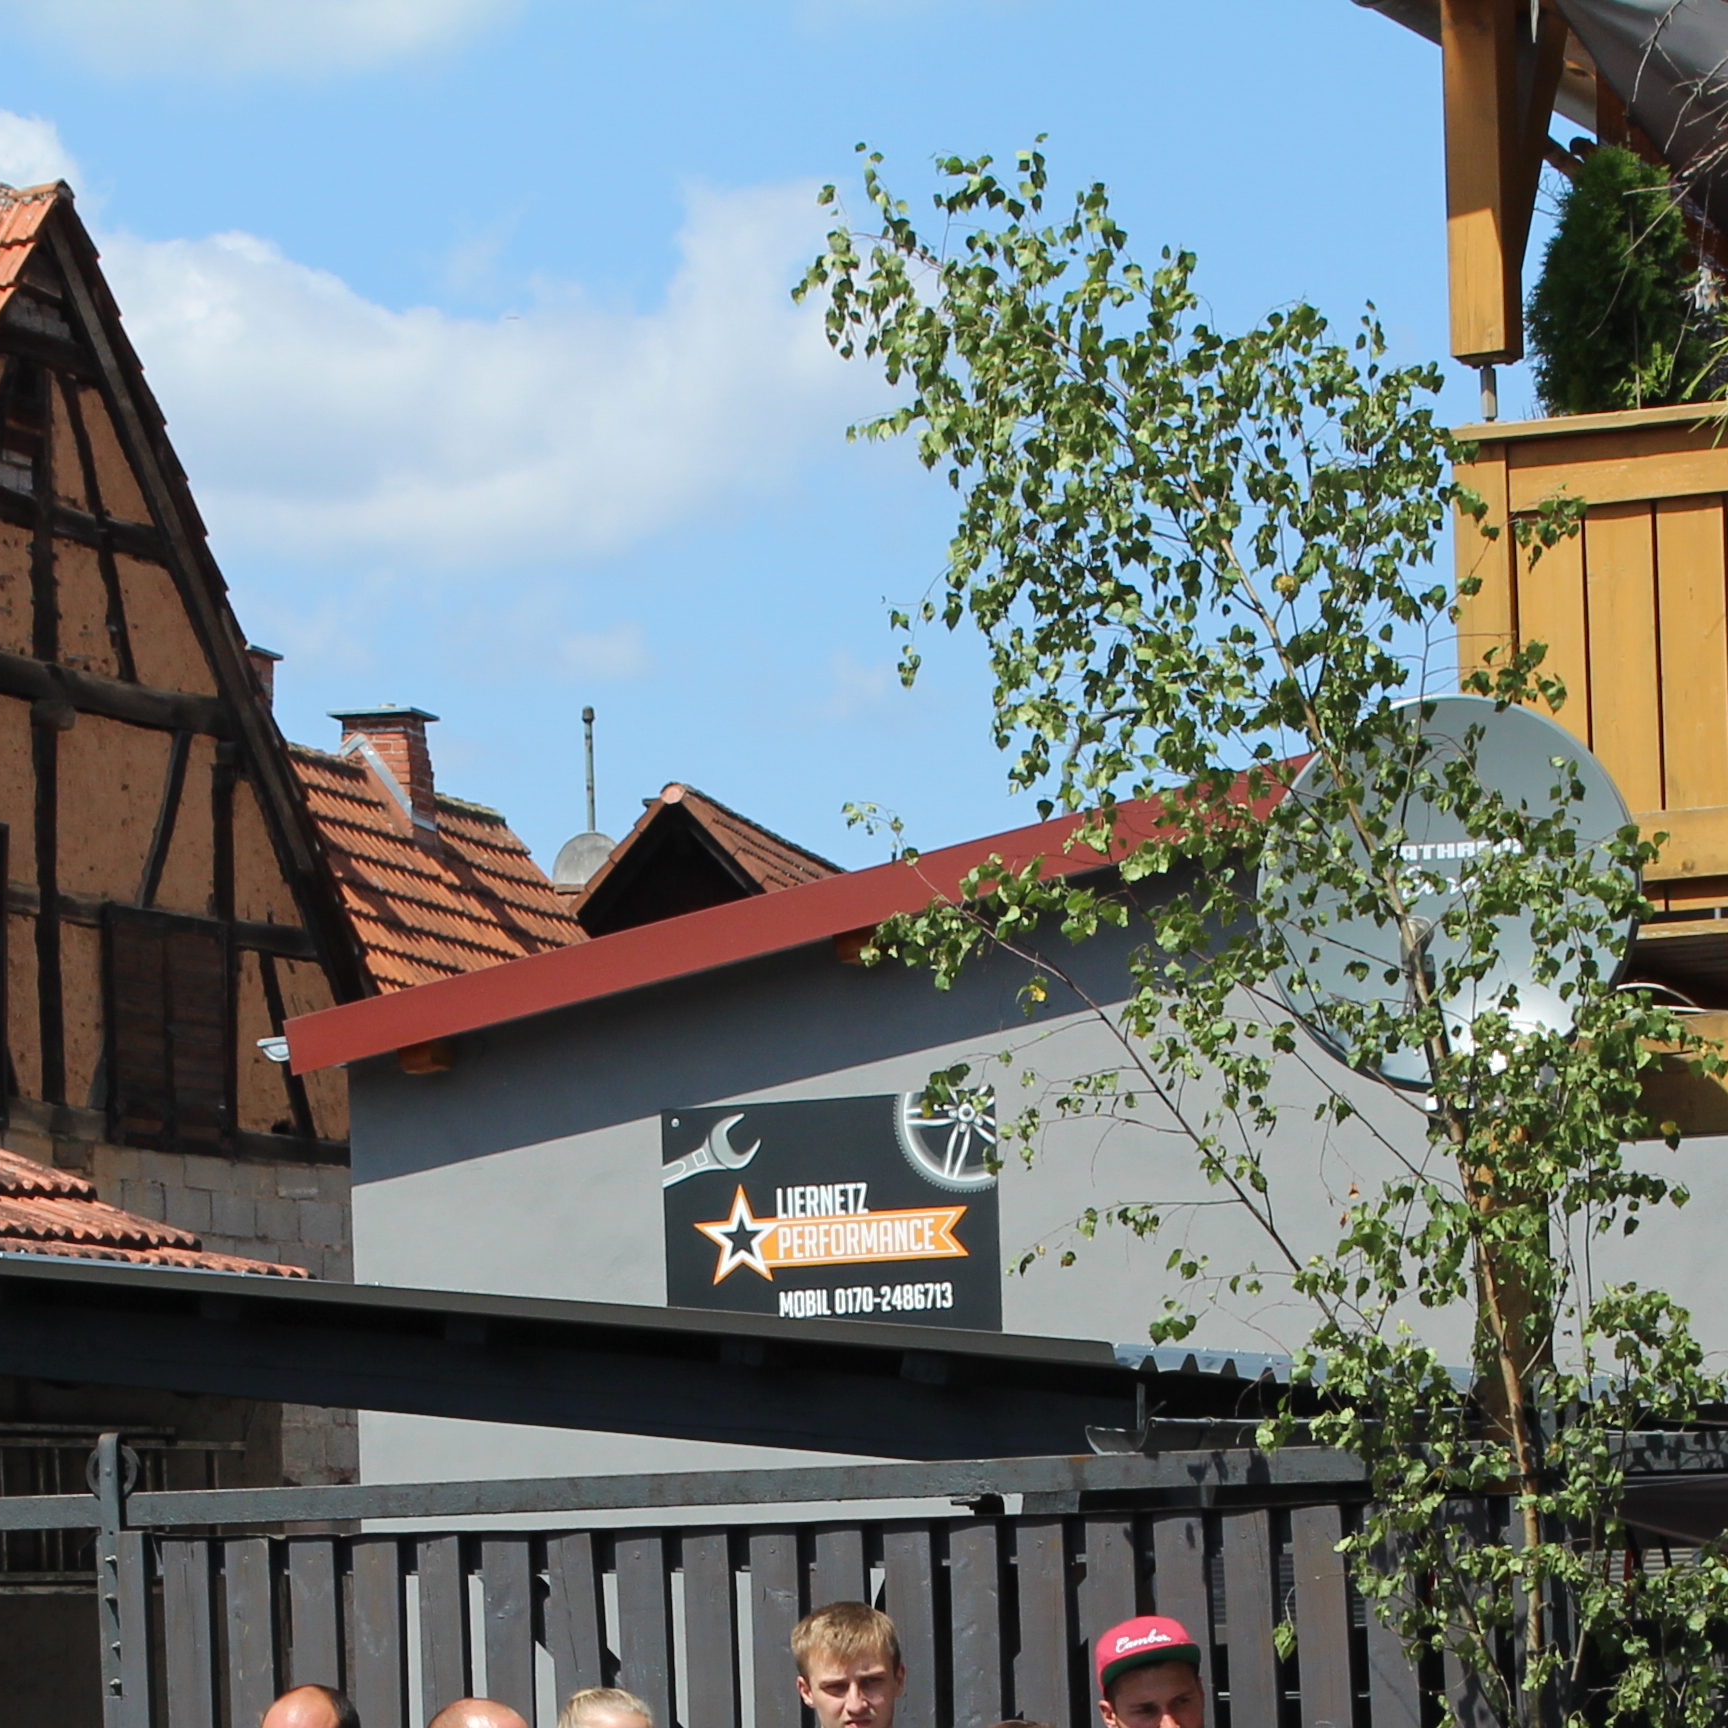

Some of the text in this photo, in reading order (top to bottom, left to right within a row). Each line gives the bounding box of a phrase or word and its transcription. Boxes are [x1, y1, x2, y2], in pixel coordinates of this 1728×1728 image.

[776, 1182, 870, 1219] LIERNETZ
[778, 1218, 936, 1259] PERFORMANCE
[779, 1281, 954, 1319] MOBIL 0170-2486713
